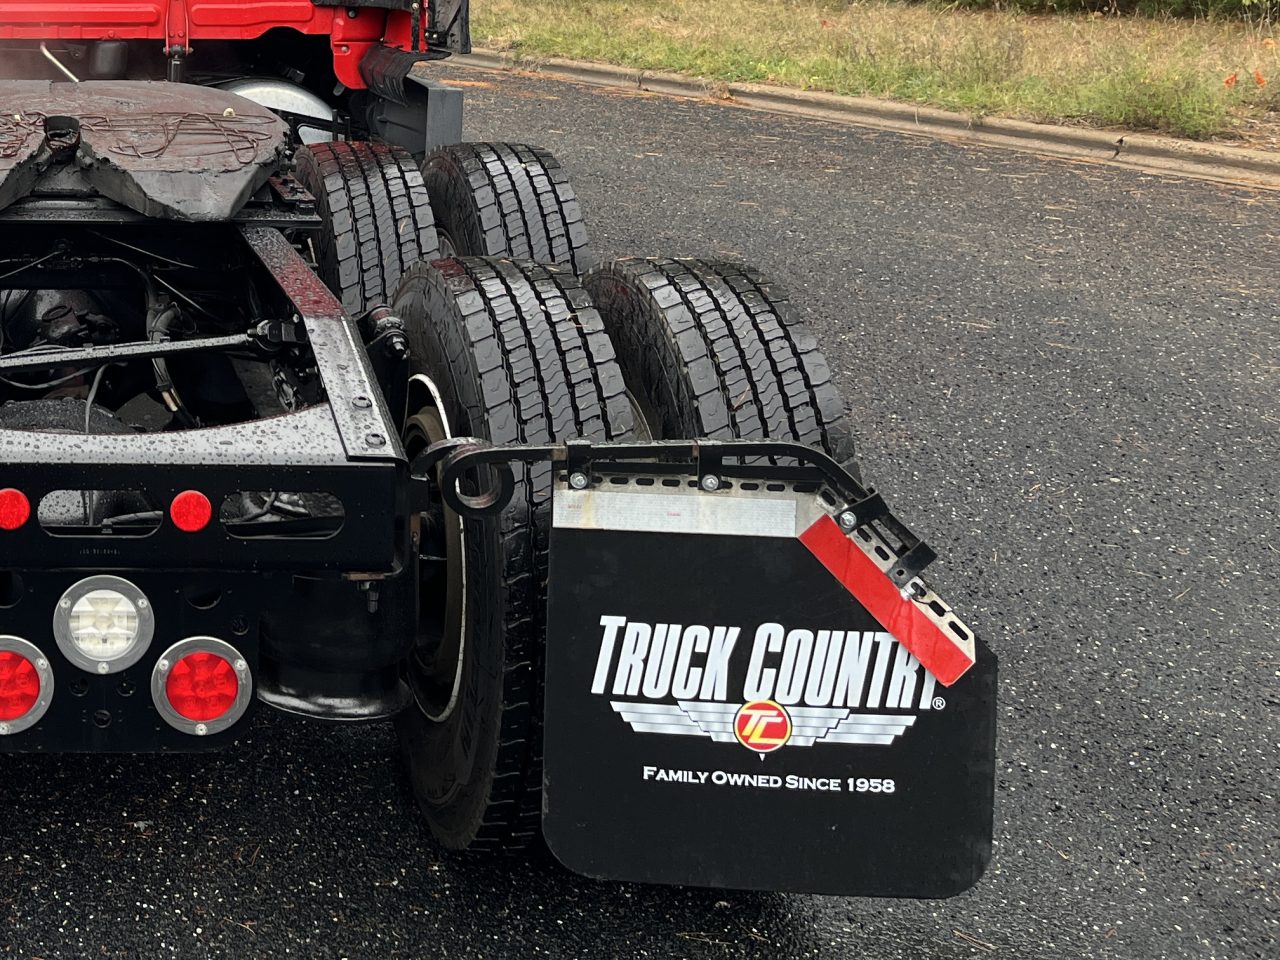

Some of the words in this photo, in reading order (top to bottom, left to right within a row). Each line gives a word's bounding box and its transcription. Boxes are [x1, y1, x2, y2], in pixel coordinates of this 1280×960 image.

[591, 615, 742, 701] TRUCK
[739, 709, 786, 744] TC
[643, 765, 709, 784] FAMILY
[711, 770, 782, 788] OWNED
[785, 774, 842, 791] SINCE
[847, 777, 896, 793] 1958
